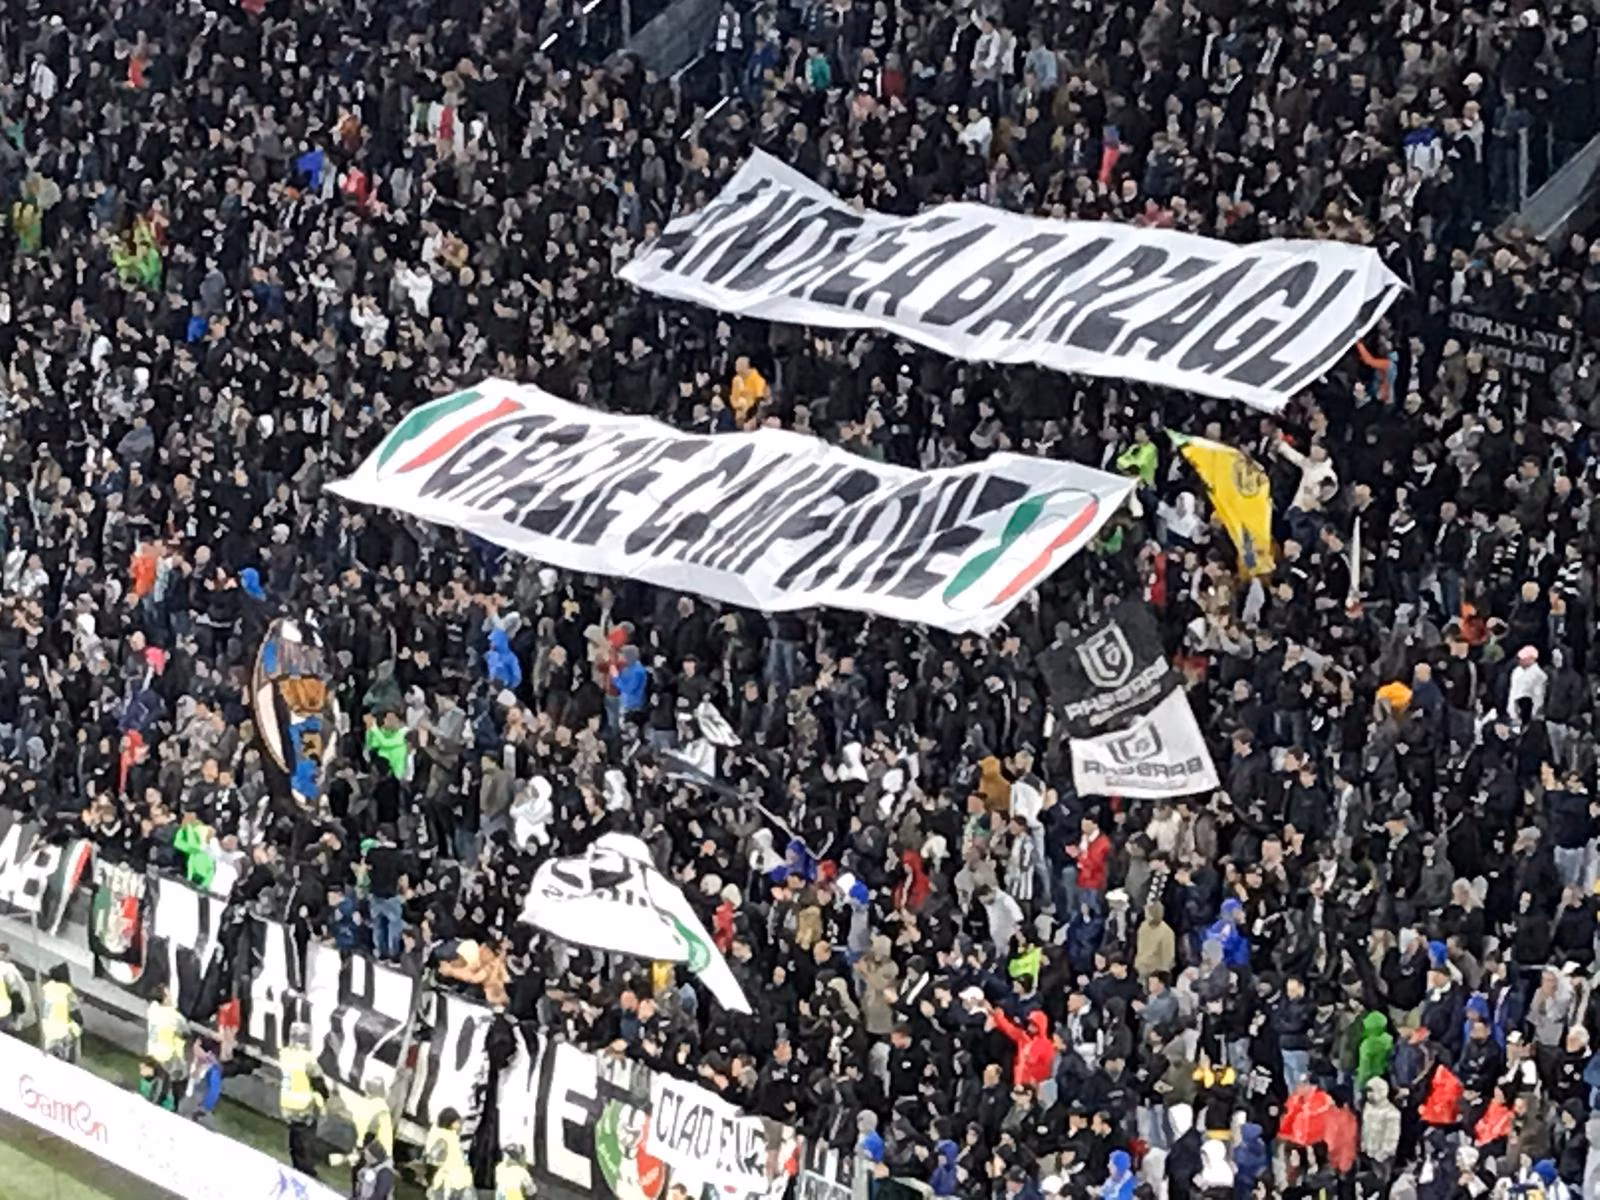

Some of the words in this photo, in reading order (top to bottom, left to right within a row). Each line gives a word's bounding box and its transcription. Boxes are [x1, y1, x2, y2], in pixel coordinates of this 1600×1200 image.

[921, 232, 1396, 391] BARZAGLI
[418, 414, 712, 545] GRAZIE
[624, 443, 1031, 600] CAMPIONE
[656, 1087, 714, 1159] CIAO
